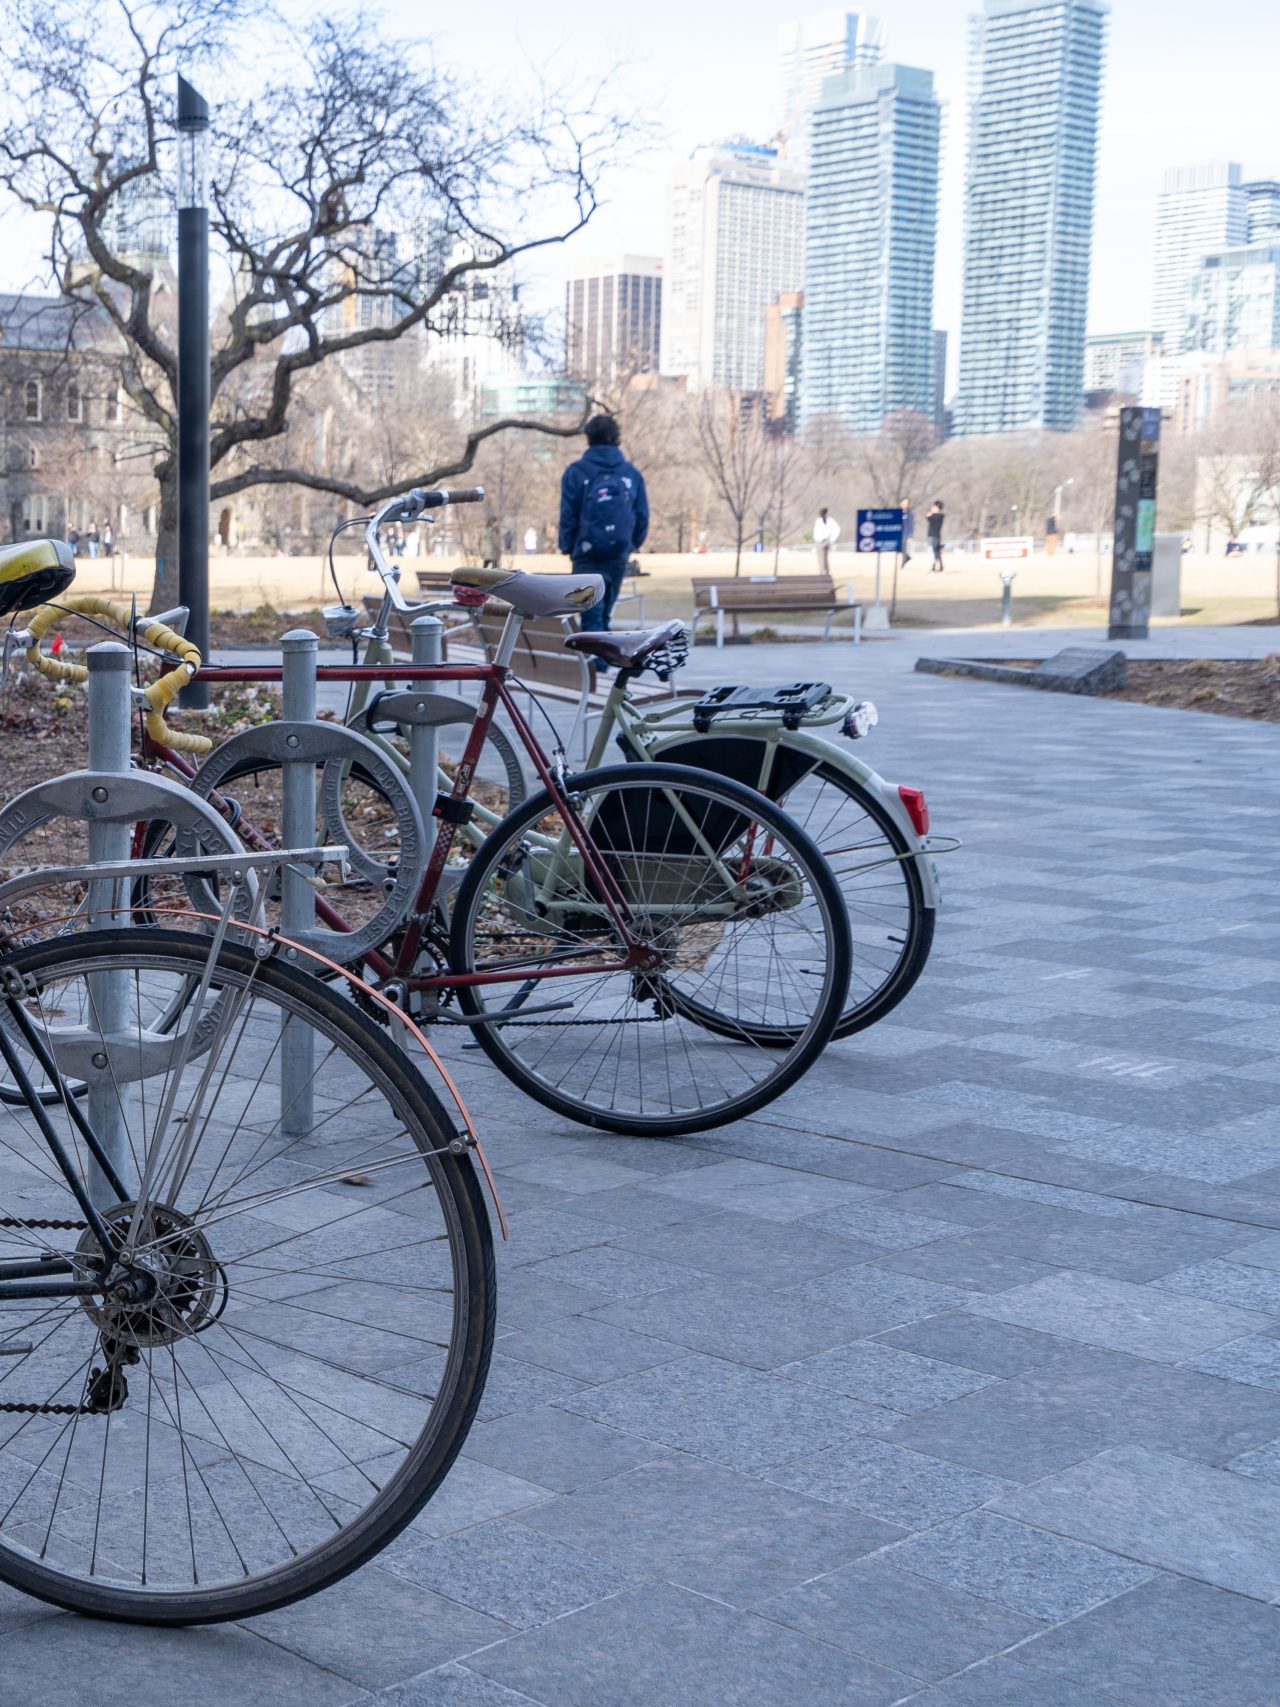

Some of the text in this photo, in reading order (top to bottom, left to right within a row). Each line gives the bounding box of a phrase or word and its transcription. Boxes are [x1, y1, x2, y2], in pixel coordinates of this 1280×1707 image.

[371, 760, 404, 800] LOCK
[490, 731, 521, 807] OCK BICYCL
[398, 805, 418, 871] BICYCLE
[393, 882, 410, 901] TO
